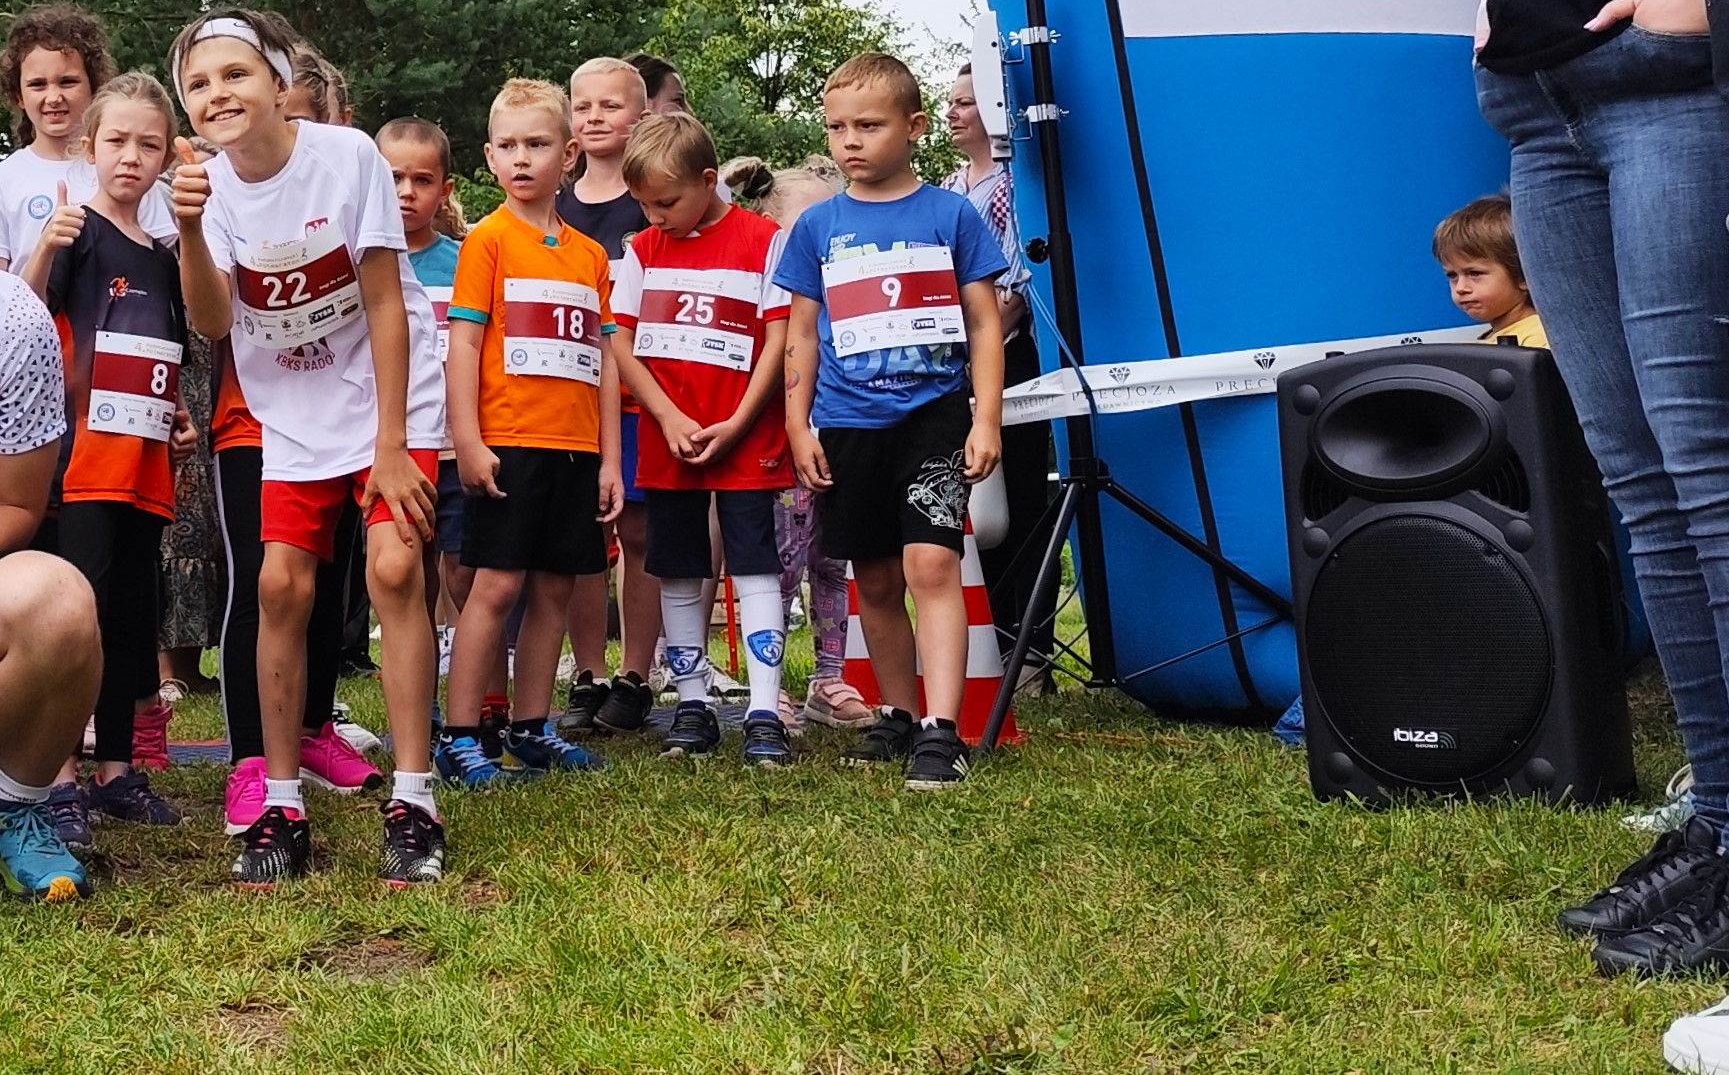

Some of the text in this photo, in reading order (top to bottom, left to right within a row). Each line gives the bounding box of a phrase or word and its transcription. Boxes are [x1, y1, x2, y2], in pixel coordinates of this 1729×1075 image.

[262, 271, 311, 307] 22
[881, 277, 902, 307] 9
[553, 307, 584, 339] 18
[675, 294, 716, 324] 25
[304, 354, 334, 372] RADO
[150, 363, 169, 395] 8
[1072, 385, 1176, 401] PECJOZA
[1393, 727, 1439, 742] ibiza
